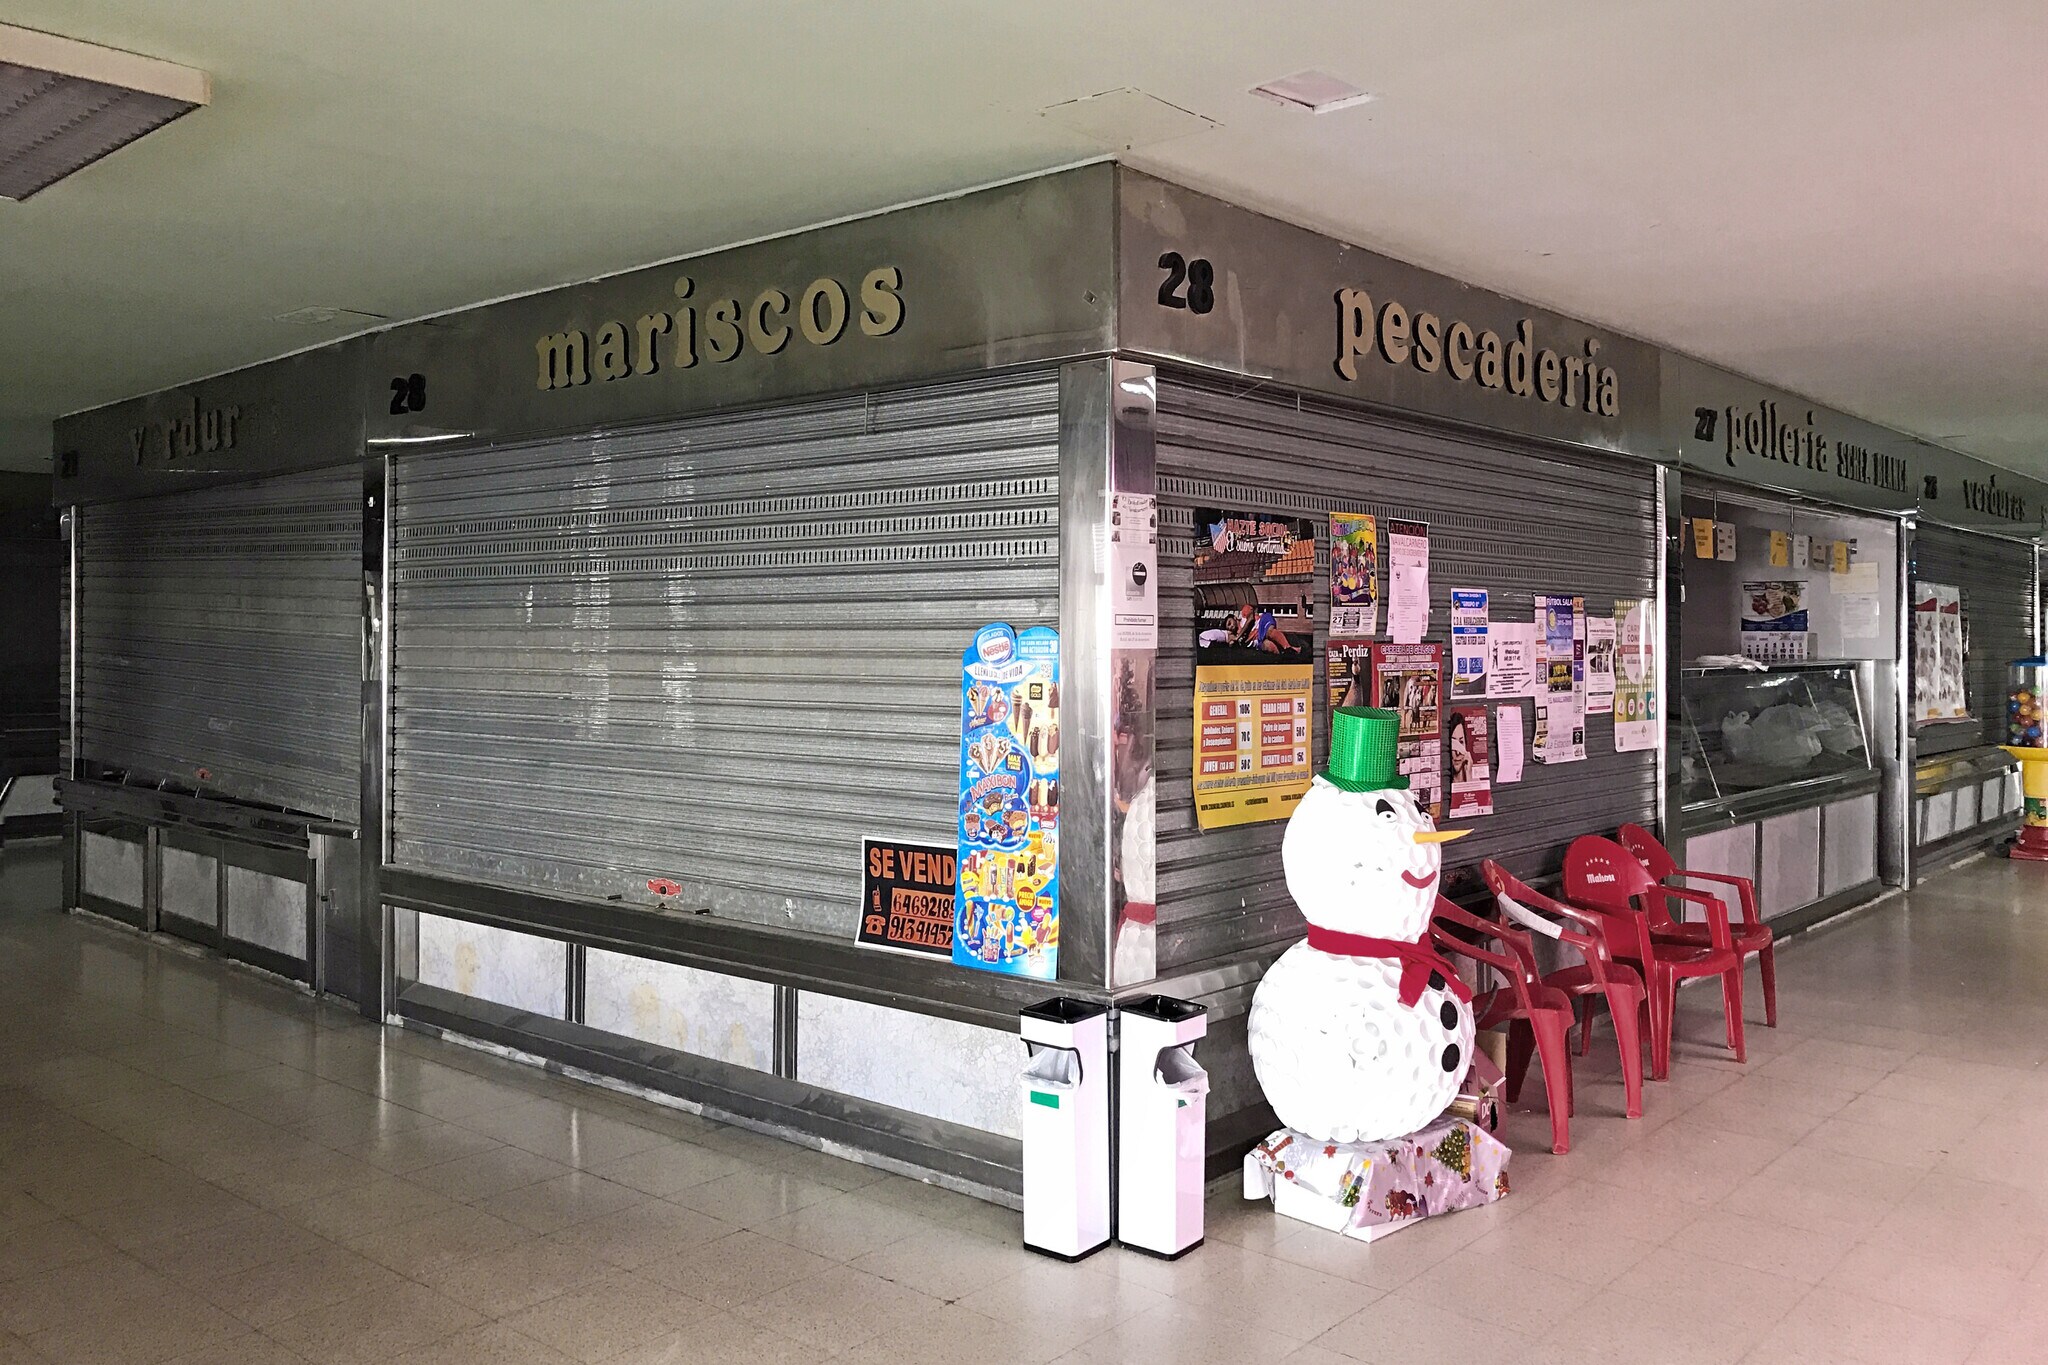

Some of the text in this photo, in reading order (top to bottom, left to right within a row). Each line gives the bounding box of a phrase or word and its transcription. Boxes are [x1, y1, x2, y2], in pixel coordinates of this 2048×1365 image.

[1157, 251, 1215, 315] 28
[535, 266, 906, 391] mariscos
[1334, 287, 1620, 418] pescaderia
[389, 372, 426, 415] 28
[1694, 406, 1718, 442] 27
[1725, 400, 1828, 473] polleria
[1226, 518, 1256, 536] HAZTE
[1389, 522, 1426, 537] ATENCIÓN
[1546, 597, 1573, 607] FÚTBOL SALA
[1332, 616, 1343, 624] 27
[982, 640, 1010, 657] Nestlé
[1342, 644, 1369, 658] Perdiz
[1380, 644, 1406, 655] CARRERA
[1413, 644, 1437, 655] GALGOS
[1008, 664, 1023, 678] VIDA
[1459, 658, 1467, 669] 30
[1209, 703, 1228, 717] GENERAL
[1007, 753, 1022, 762] MAX
[1203, 760, 1219, 773] JOVEN
[969, 774, 1017, 802] MAXIBON
[869, 846, 957, 886] SE VEND
[1586, 872, 1616, 884] Mahou
